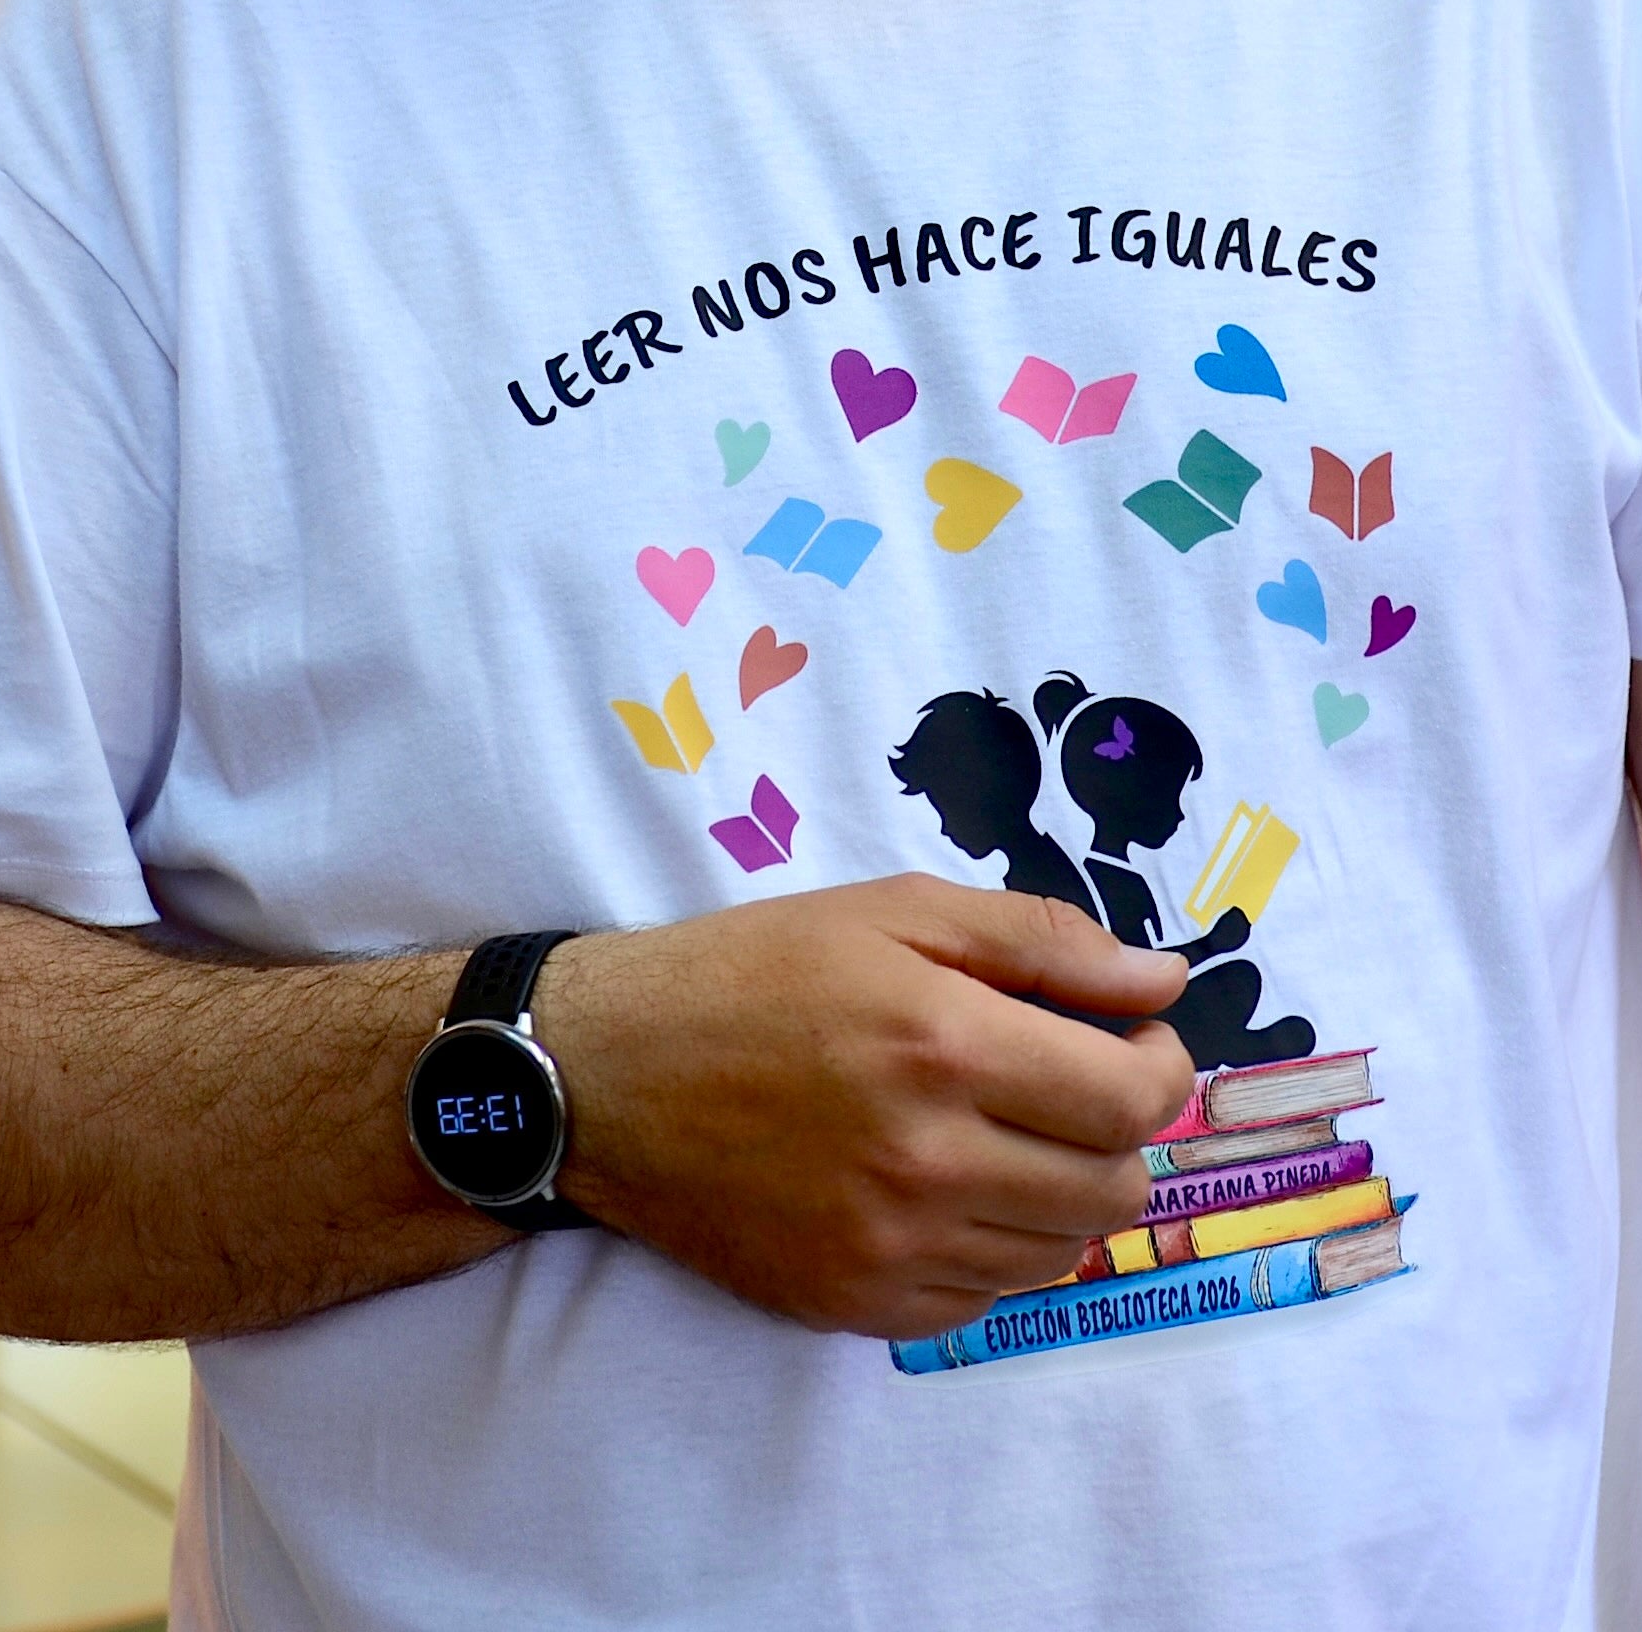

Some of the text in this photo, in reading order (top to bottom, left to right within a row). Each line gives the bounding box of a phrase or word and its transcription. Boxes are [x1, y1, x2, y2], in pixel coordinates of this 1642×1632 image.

[506, 205, 1379, 427] LEER NOS HACE IGUALES
[1143, 1159, 1333, 1218] MARIANA PINEDA
[983, 1274, 1242, 1354] EDICIÓN BIBLIOTECA 2026
